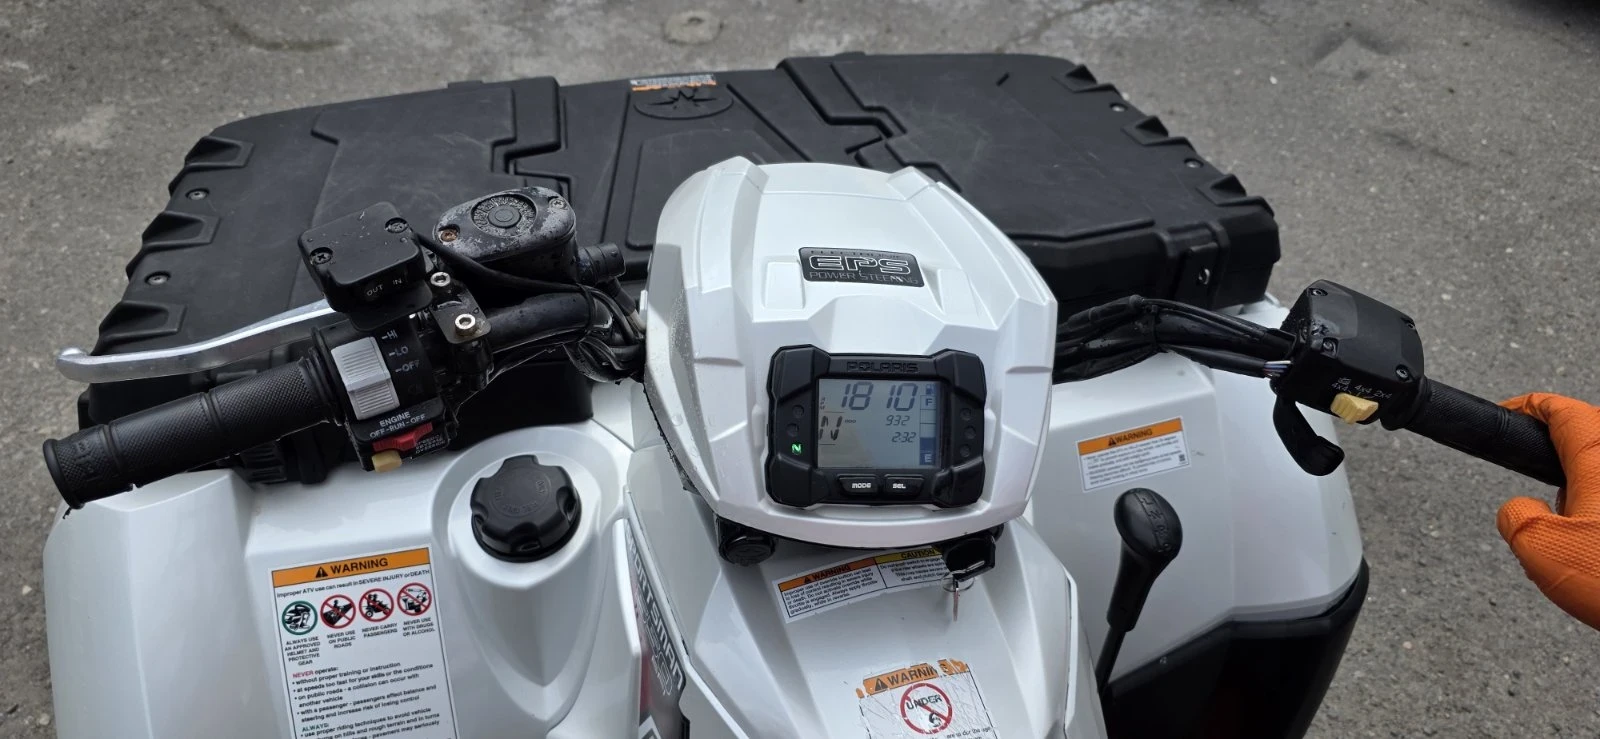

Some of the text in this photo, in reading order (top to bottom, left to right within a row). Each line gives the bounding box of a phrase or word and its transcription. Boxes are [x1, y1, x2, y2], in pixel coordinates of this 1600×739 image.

[808, 254, 911, 275] EPS
[808, 271, 857, 280] POWER
[367, 285, 383, 296] OUT
[387, 329, 398, 339] HI
[395, 346, 409, 356] LO
[402, 360, 420, 372] OFF
[846, 360, 920, 374] POLARIS
[924, 398, 934, 407] F
[379, 411, 411, 427] ENGINE
[885, 414, 910, 426] 932
[1115, 428, 1153, 443] WARNING
[790, 443, 802, 454] N
[923, 455, 932, 464] E
[851, 482, 872, 490] MODE
[900, 549, 936, 559] CAUTION
[330, 557, 388, 575] WARNING
[812, 564, 850, 581] WARNING
[276, 589, 302, 598] Improper
[336, 581, 353, 589] result
[359, 576, 382, 585] SEVERE
[382, 573, 404, 581] INJURY
[410, 569, 430, 577] DEATH
[403, 618, 420, 626] NEVER
[415, 621, 434, 629] DRUGS
[326, 631, 344, 639] NEVER
[363, 628, 398, 637] PASSENGERS
[411, 627, 435, 635] ALCOHOL
[286, 637, 308, 645] ALWAYS
[292, 641, 321, 650] APPROVED
[333, 641, 352, 649] ROADS
[286, 648, 308, 657] HELMET
[288, 652, 320, 662] PROTECTIVE
[296, 677, 317, 685] without
[318, 674, 338, 682] proper
[338, 669, 361, 677] training
[369, 662, 401, 671] instruction
[403, 663, 434, 673] conditions
[292, 670, 314, 678] NEVER
[307, 691, 325, 699] public
[352, 681, 377, 690] collision
[298, 695, 343, 708] another vehicle
[318, 702, 348, 713] passenger
[352, 695, 385, 705] passengers
[403, 687, 425, 695] balance
[906, 694, 943, 710] UNDER
[301, 714, 325, 722] steering
[337, 707, 361, 716] increase
[381, 699, 399, 707] losing
[400, 695, 420, 703] control
[316, 727, 335, 736] proper
[336, 723, 354, 731] riding
[354, 717, 386, 727] techniques
[394, 711, 410, 719] avoid
[411, 707, 431, 715] vehicle
[368, 724, 386, 732] rough
[386, 720, 405, 728] terrain
[372, 728, 400, 739] pavement
[413, 720, 440, 729] seriously
